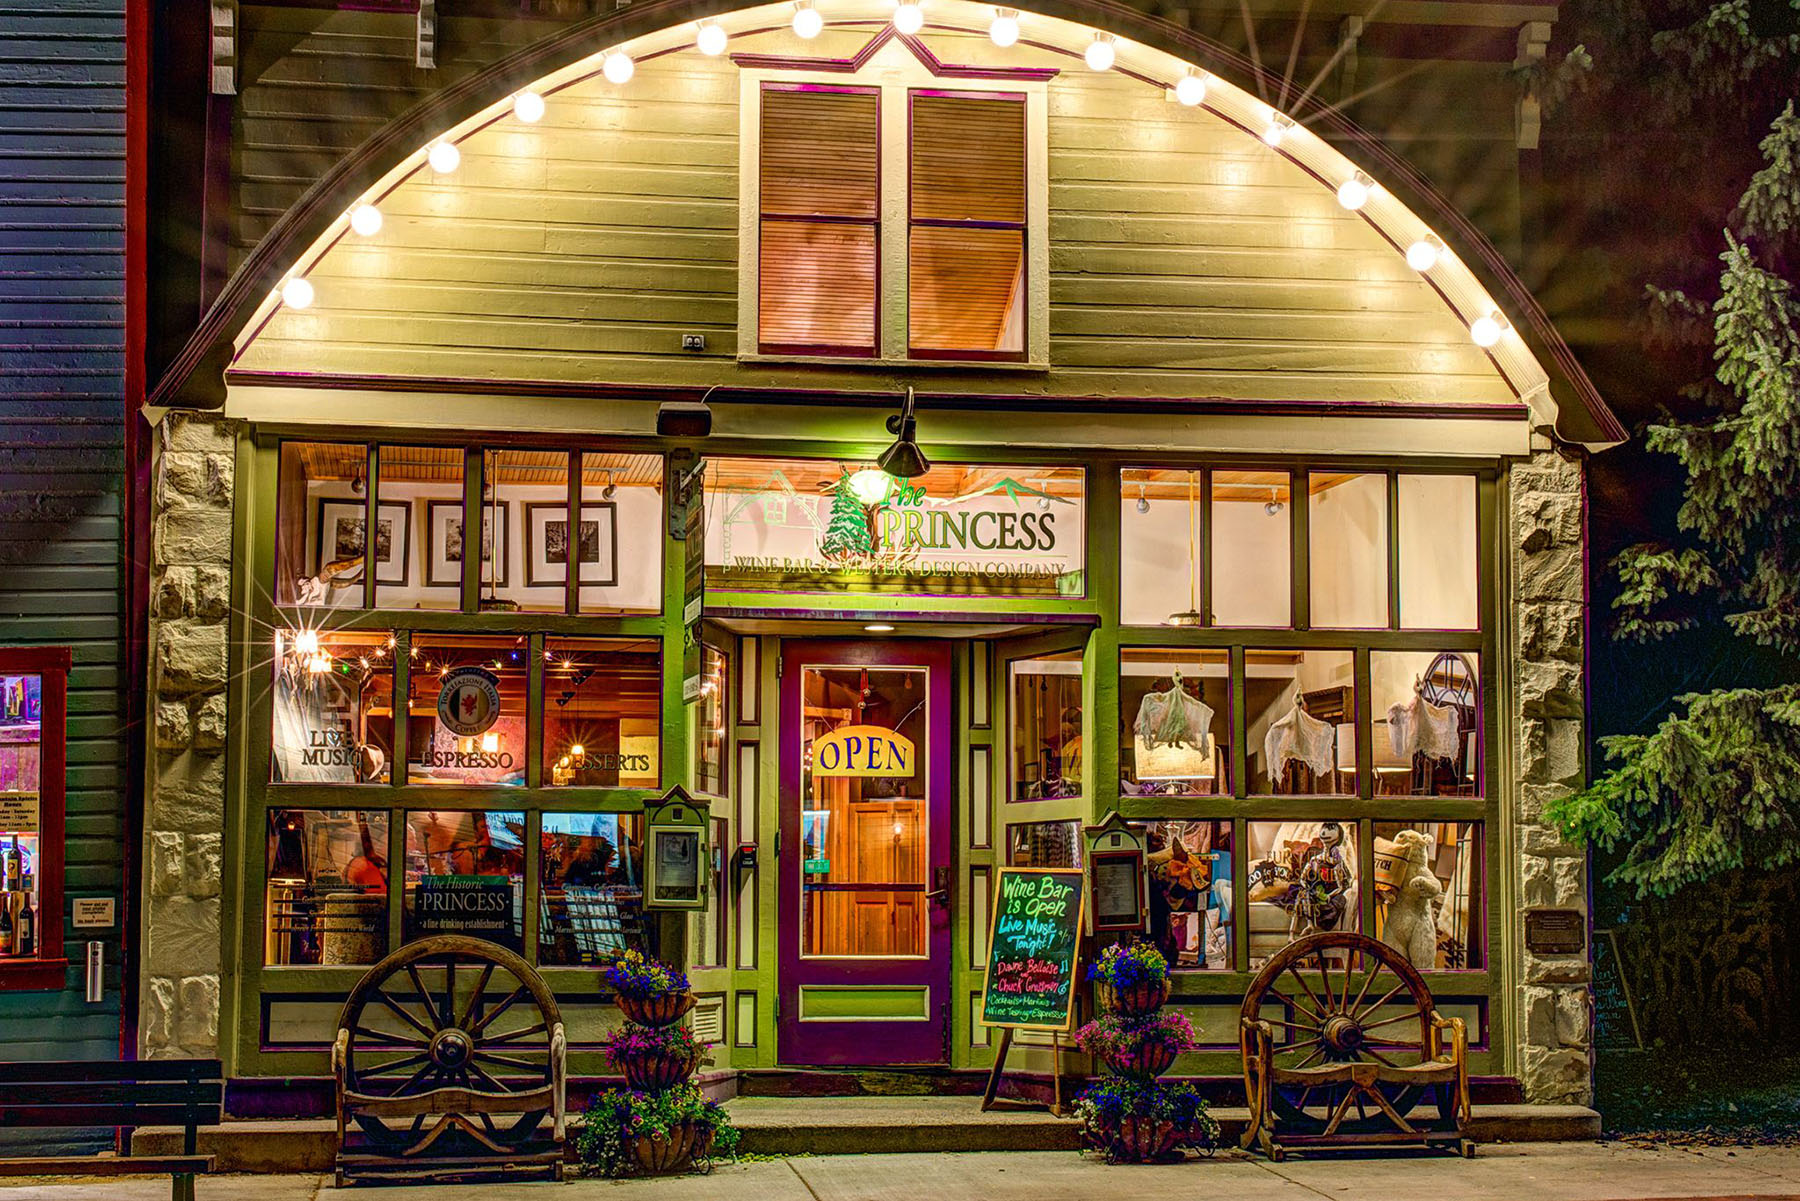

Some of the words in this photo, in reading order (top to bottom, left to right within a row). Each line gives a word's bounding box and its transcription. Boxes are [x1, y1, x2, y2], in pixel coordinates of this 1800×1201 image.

[880, 476, 925, 506] The
[880, 510, 1056, 551] PRINCESS
[734, 555, 779, 573] WINE
[783, 557, 814, 574] BAR
[816, 558, 832, 575] &
[839, 558, 915, 577] WESTERN
[920, 561, 980, 577] DESIGN
[984, 561, 1065, 580] COMPANY
[310, 730, 354, 747] LIVE
[301, 749, 360, 766] MUSIC
[421, 751, 513, 769] ESPRESSO
[558, 752, 650, 772] DESSERTS
[820, 736, 907, 770] OPEN
[426, 876, 443, 889] The
[445, 875, 485, 890] Historic
[1003, 875, 1035, 899] Wine
[1037, 876, 1074, 899] Bar
[422, 892, 505, 911] PRINCESS
[1007, 899, 1021, 914] is
[1026, 898, 1066, 917] Open
[440, 919, 464, 931] drinking
[465, 919, 505, 929] establishment
[998, 915, 1024, 934] Live
[1025, 918, 1057, 936] Music
[1007, 933, 1055, 957] Tonight!
[998, 977, 1024, 994] Chuck
